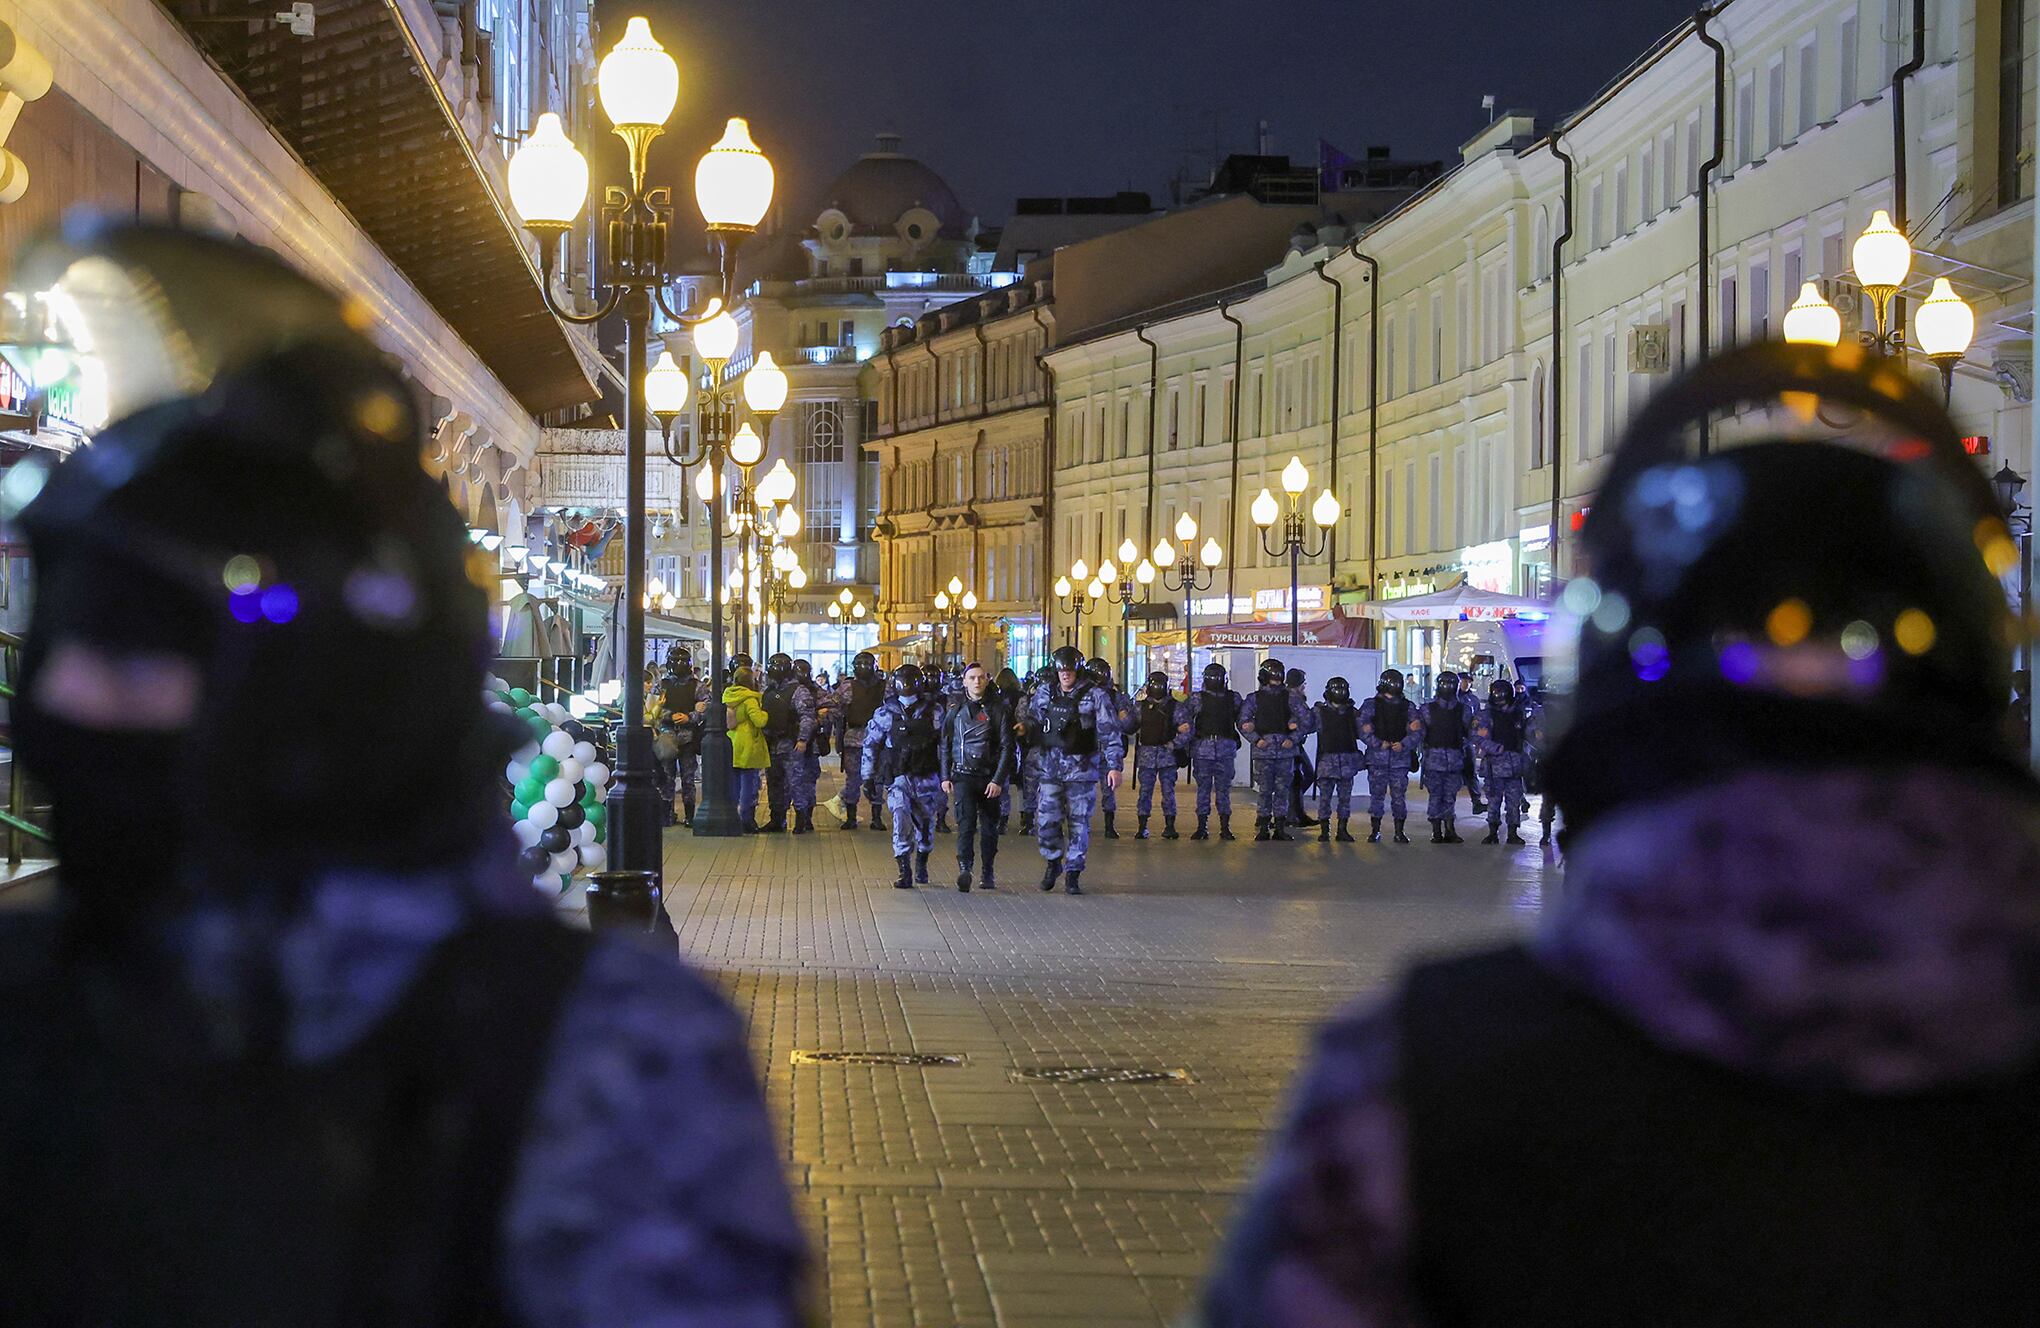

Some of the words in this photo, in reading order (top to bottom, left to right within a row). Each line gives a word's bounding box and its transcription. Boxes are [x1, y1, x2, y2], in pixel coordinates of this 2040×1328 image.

[1410, 608, 1431, 616] КАФЕ
[1210, 633, 1259, 643] ТУРЕЦКАЯ
[1261, 634, 1293, 643] КУХНЯ
